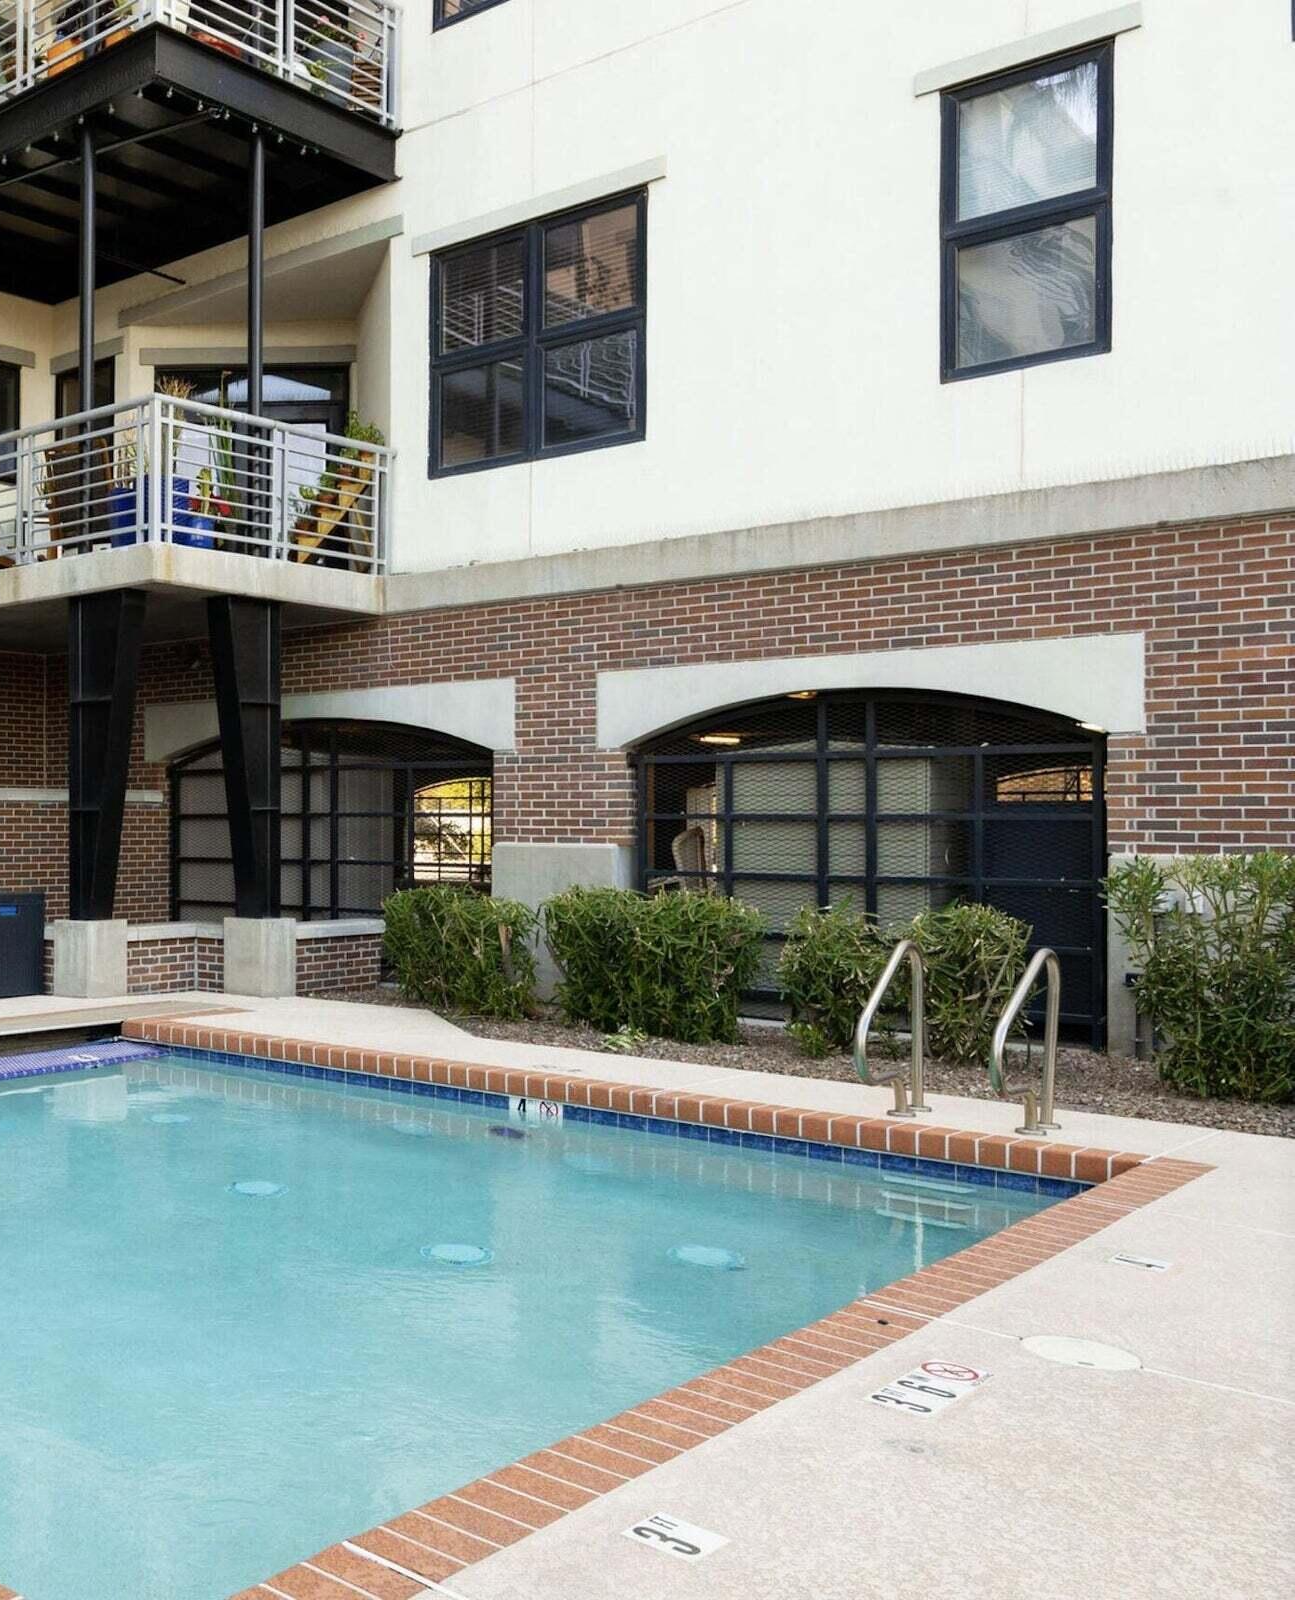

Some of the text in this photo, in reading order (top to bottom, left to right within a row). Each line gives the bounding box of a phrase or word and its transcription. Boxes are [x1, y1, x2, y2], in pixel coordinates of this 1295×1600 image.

[897, 1380, 957, 1398] 6
[871, 1394, 932, 1413] 3
[632, 1526, 702, 1555] 3
